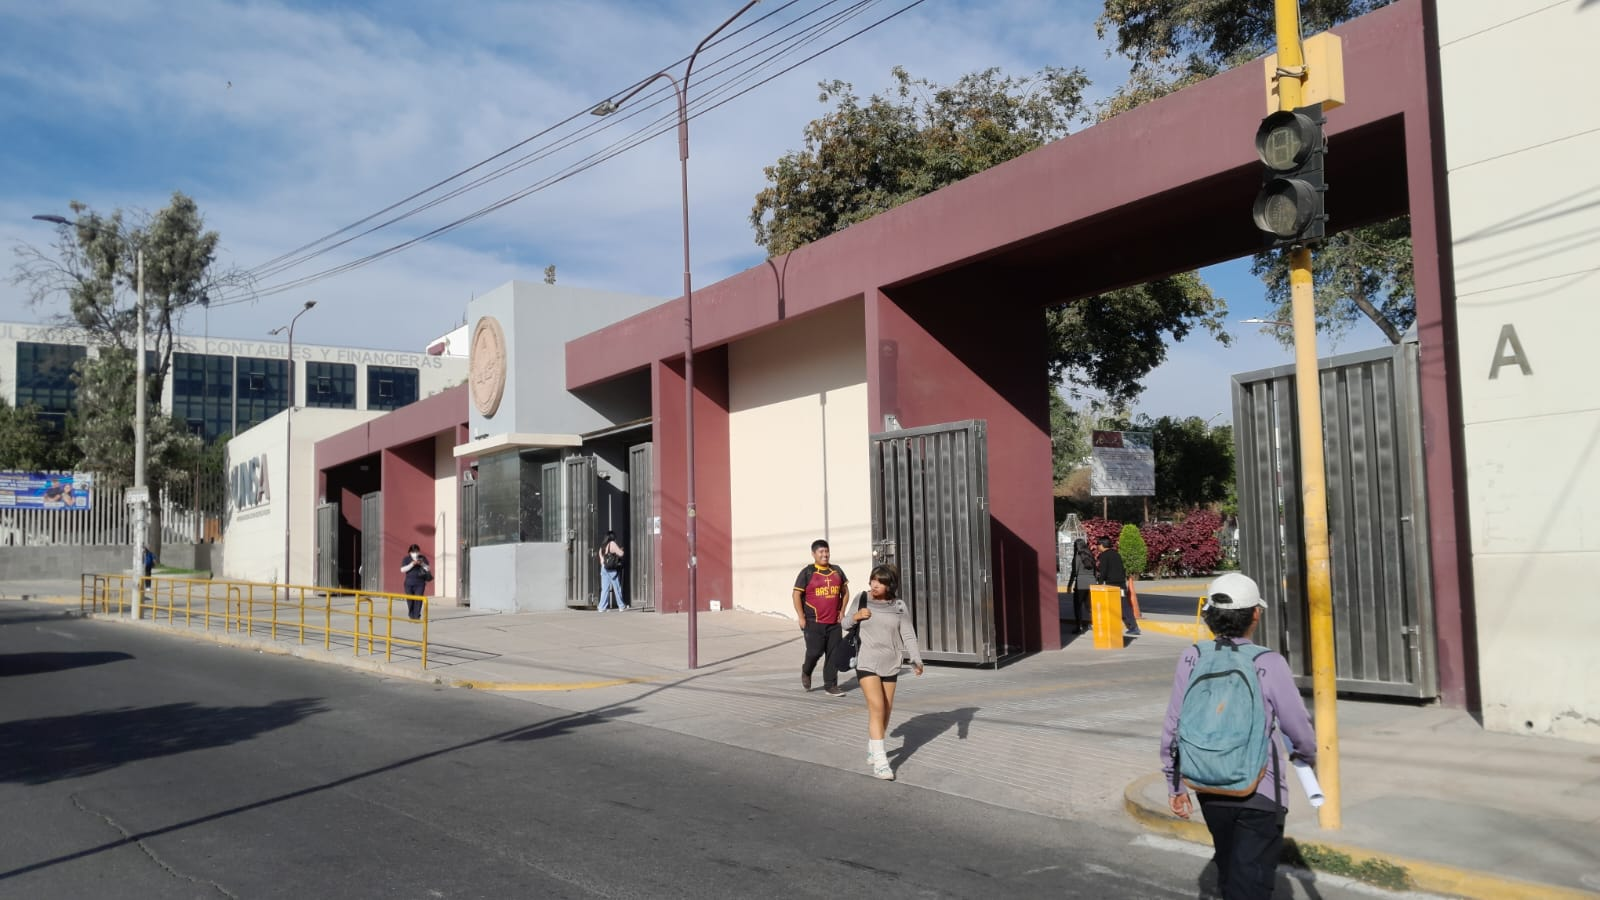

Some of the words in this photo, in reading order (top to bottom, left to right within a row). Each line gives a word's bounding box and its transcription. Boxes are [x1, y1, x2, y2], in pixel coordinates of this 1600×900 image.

[208, 341, 312, 360] CONTABLES
[320, 349, 331, 361] Y
[337, 350, 443, 369] FINANCIERAS
[1488, 323, 1534, 380] A
